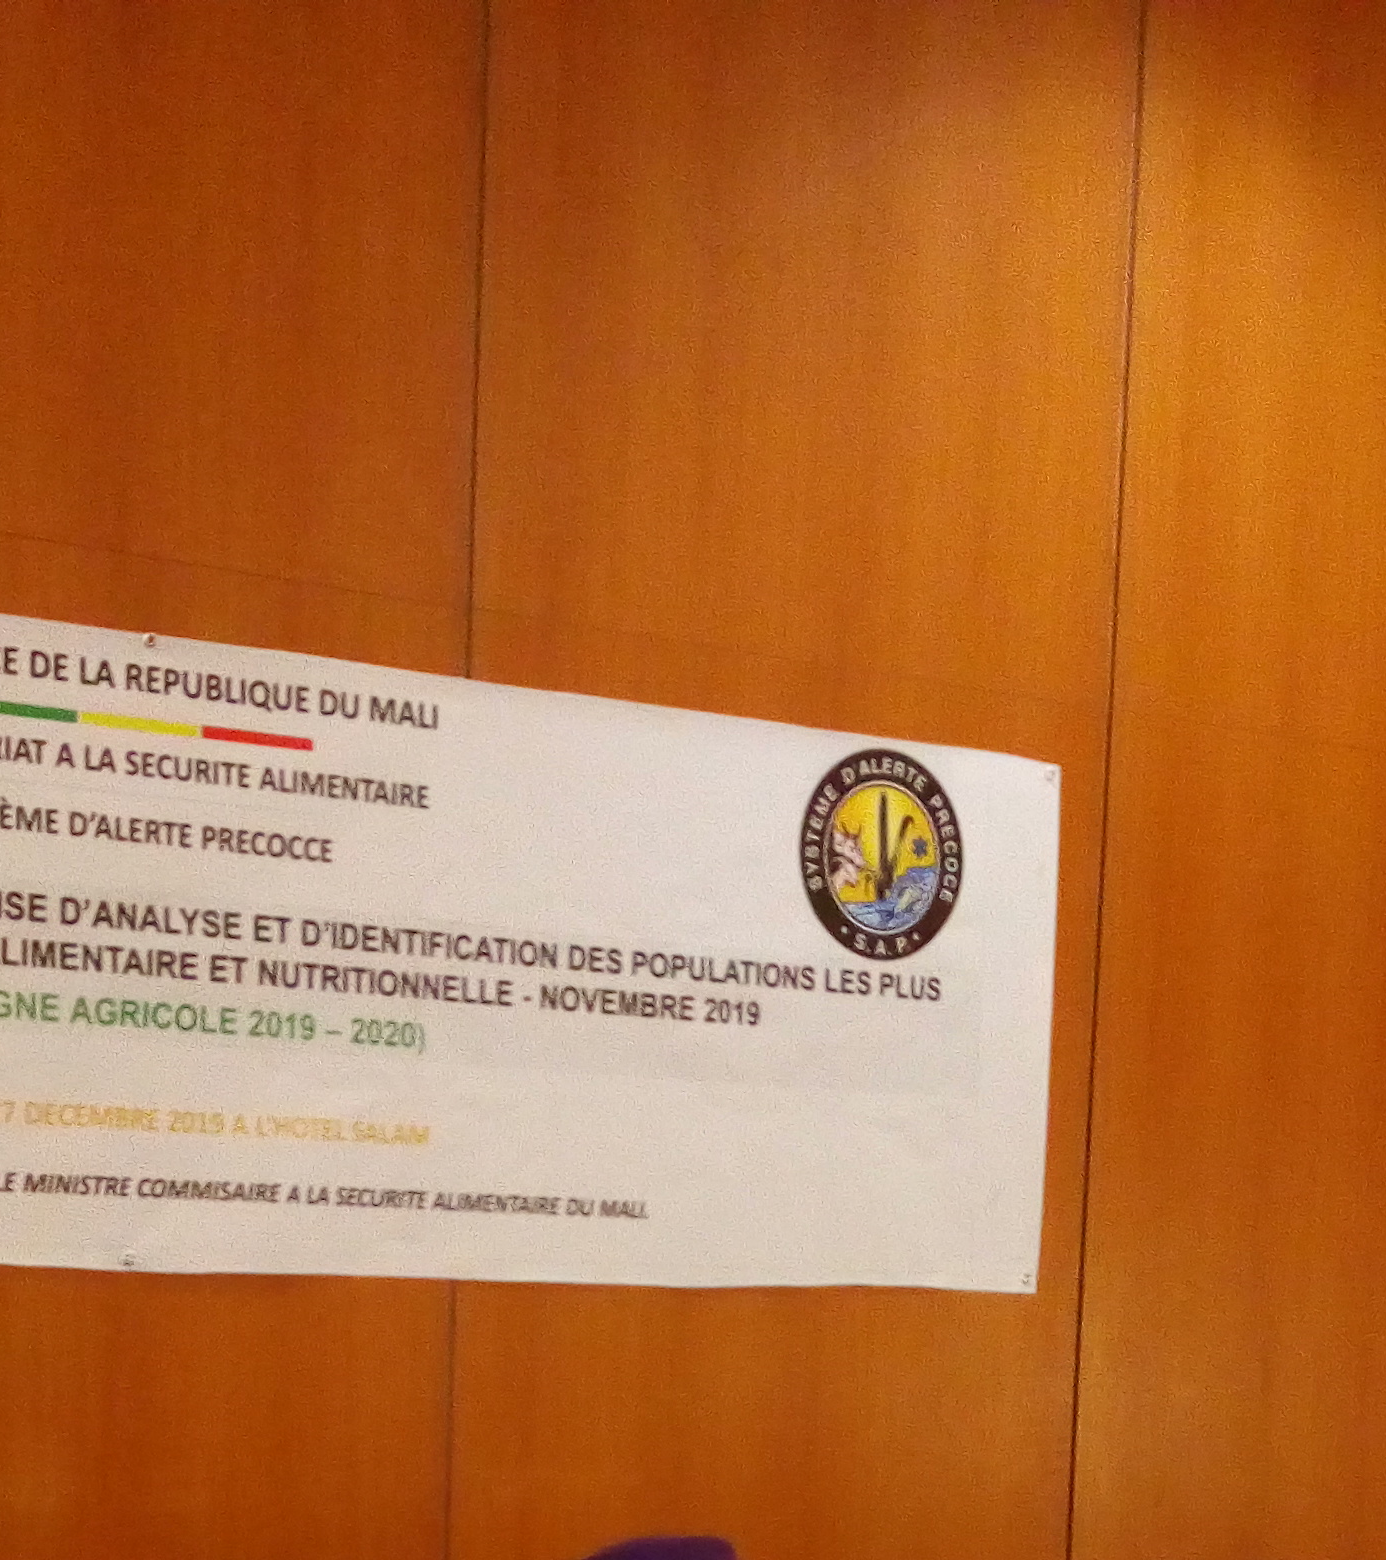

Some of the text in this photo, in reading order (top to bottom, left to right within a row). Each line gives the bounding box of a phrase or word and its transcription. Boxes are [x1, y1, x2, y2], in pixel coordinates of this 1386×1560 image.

[29, 650, 69, 682] DE
[79, 656, 116, 689] LA
[125, 663, 310, 713] REPUBLIQUE
[319, 689, 360, 719] DU
[369, 696, 439, 729] MALI
[55, 743, 75, 768] A
[85, 745, 116, 773] LA
[125, 750, 252, 789] SECURITE
[259, 767, 430, 809] ALIMENTAIRE
[69, 812, 192, 848] D'ALERTE
[201, 825, 333, 863] PRECOCCE
[930, 793, 960, 903] PRECOCE
[60, 896, 242, 939] D'ANALYSE
[252, 914, 291, 944] ET
[300, 918, 557, 968] D'IDENTIFICATION
[567, 943, 623, 975] DES
[631, 950, 815, 991] POPULATIONS
[823, 966, 871, 996] LES
[879, 975, 942, 1001] PLUS
[208, 954, 249, 984] ET
[257, 959, 513, 1008] NUTRITIONNELLE
[539, 984, 695, 1021] NOVEMBRE
[703, 999, 761, 1026] 2019
[69, 996, 239, 1036] AGRICOLE
[249, 1009, 317, 1041] 2019
[349, 1016, 426, 1055] 2020)
[23, 1101, 158, 1132] DECEMBRE
[233, 1113, 248, 1135] A
[351, 1120, 430, 1145] SALAM
[22, 1173, 132, 1198] MINISTRE
[286, 1184, 301, 1204] A
[307, 1186, 329, 1206] LA
[335, 1186, 427, 1210] SECURITE
[434, 1191, 561, 1216] ALIMENTAIRE
[566, 1197, 595, 1217] DU
[599, 1198, 650, 1219] MALI
